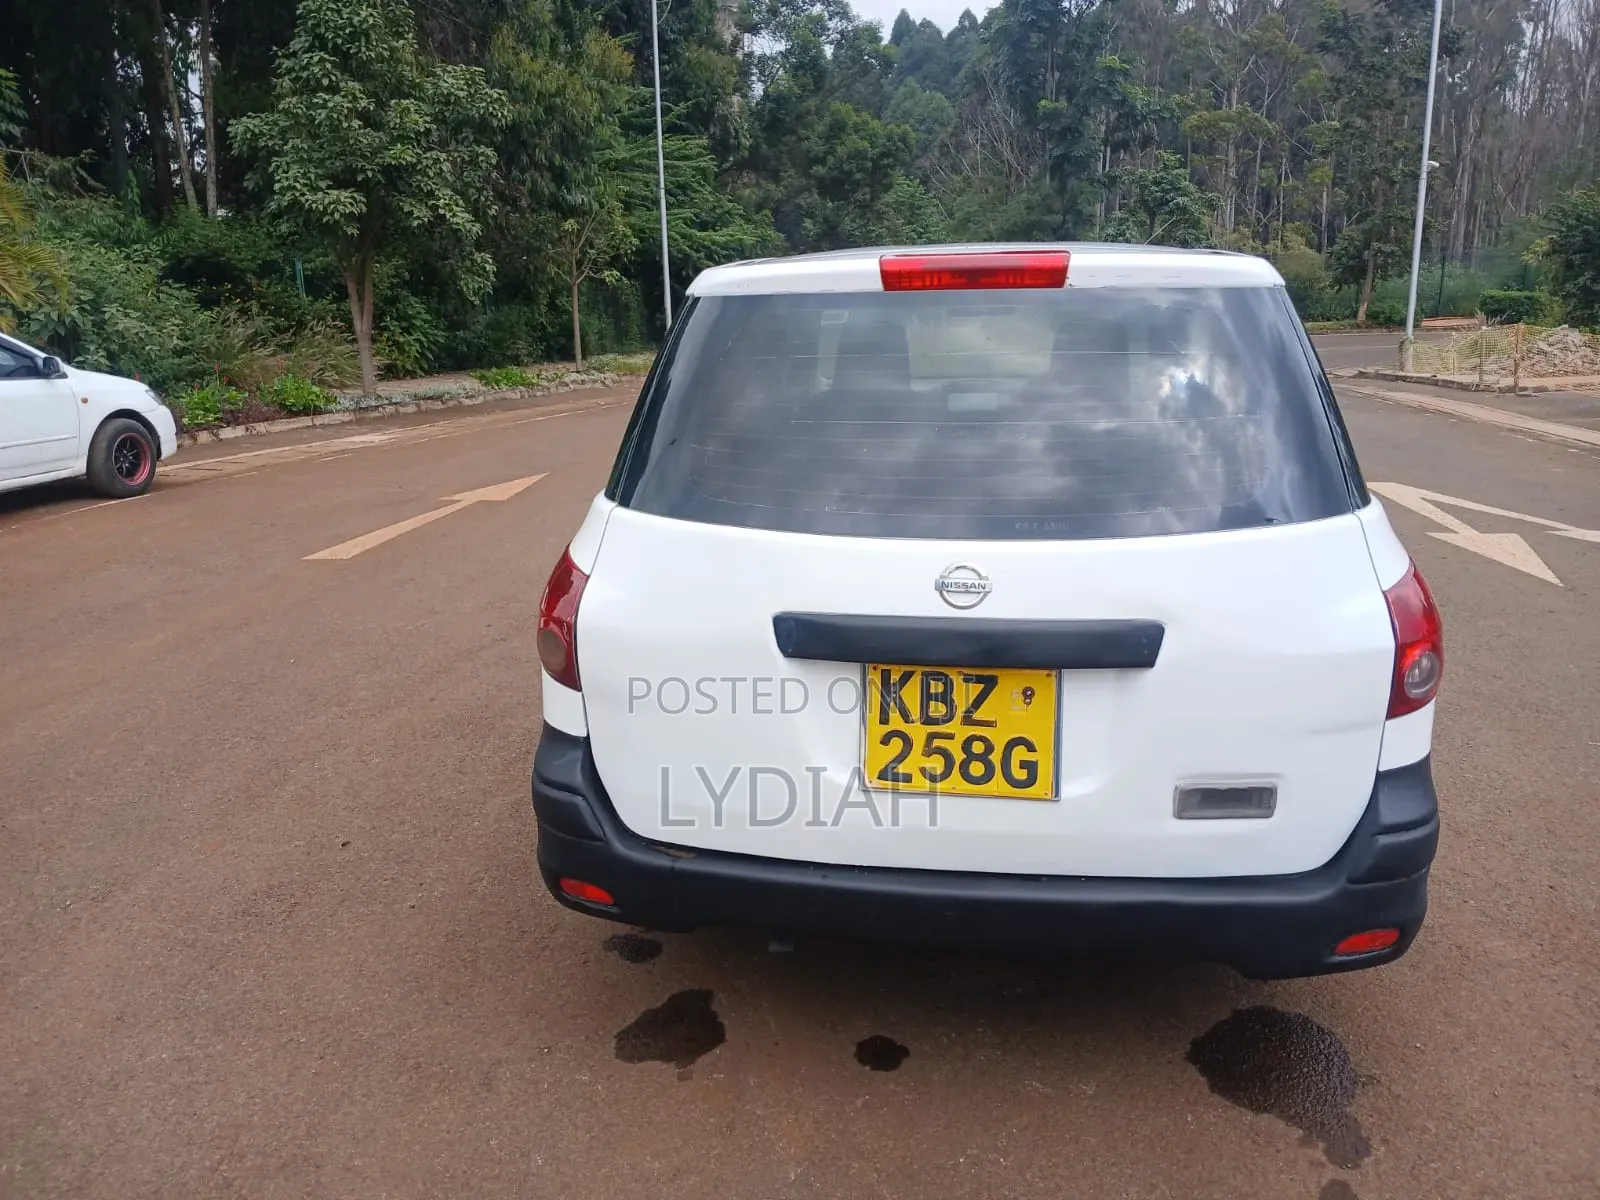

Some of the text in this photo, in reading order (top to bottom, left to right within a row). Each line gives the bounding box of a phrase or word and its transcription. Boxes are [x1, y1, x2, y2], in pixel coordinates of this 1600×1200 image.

[941, 581, 987, 590] NISSAN
[879, 669, 998, 727] KBZ
[876, 729, 1038, 789] 258G
